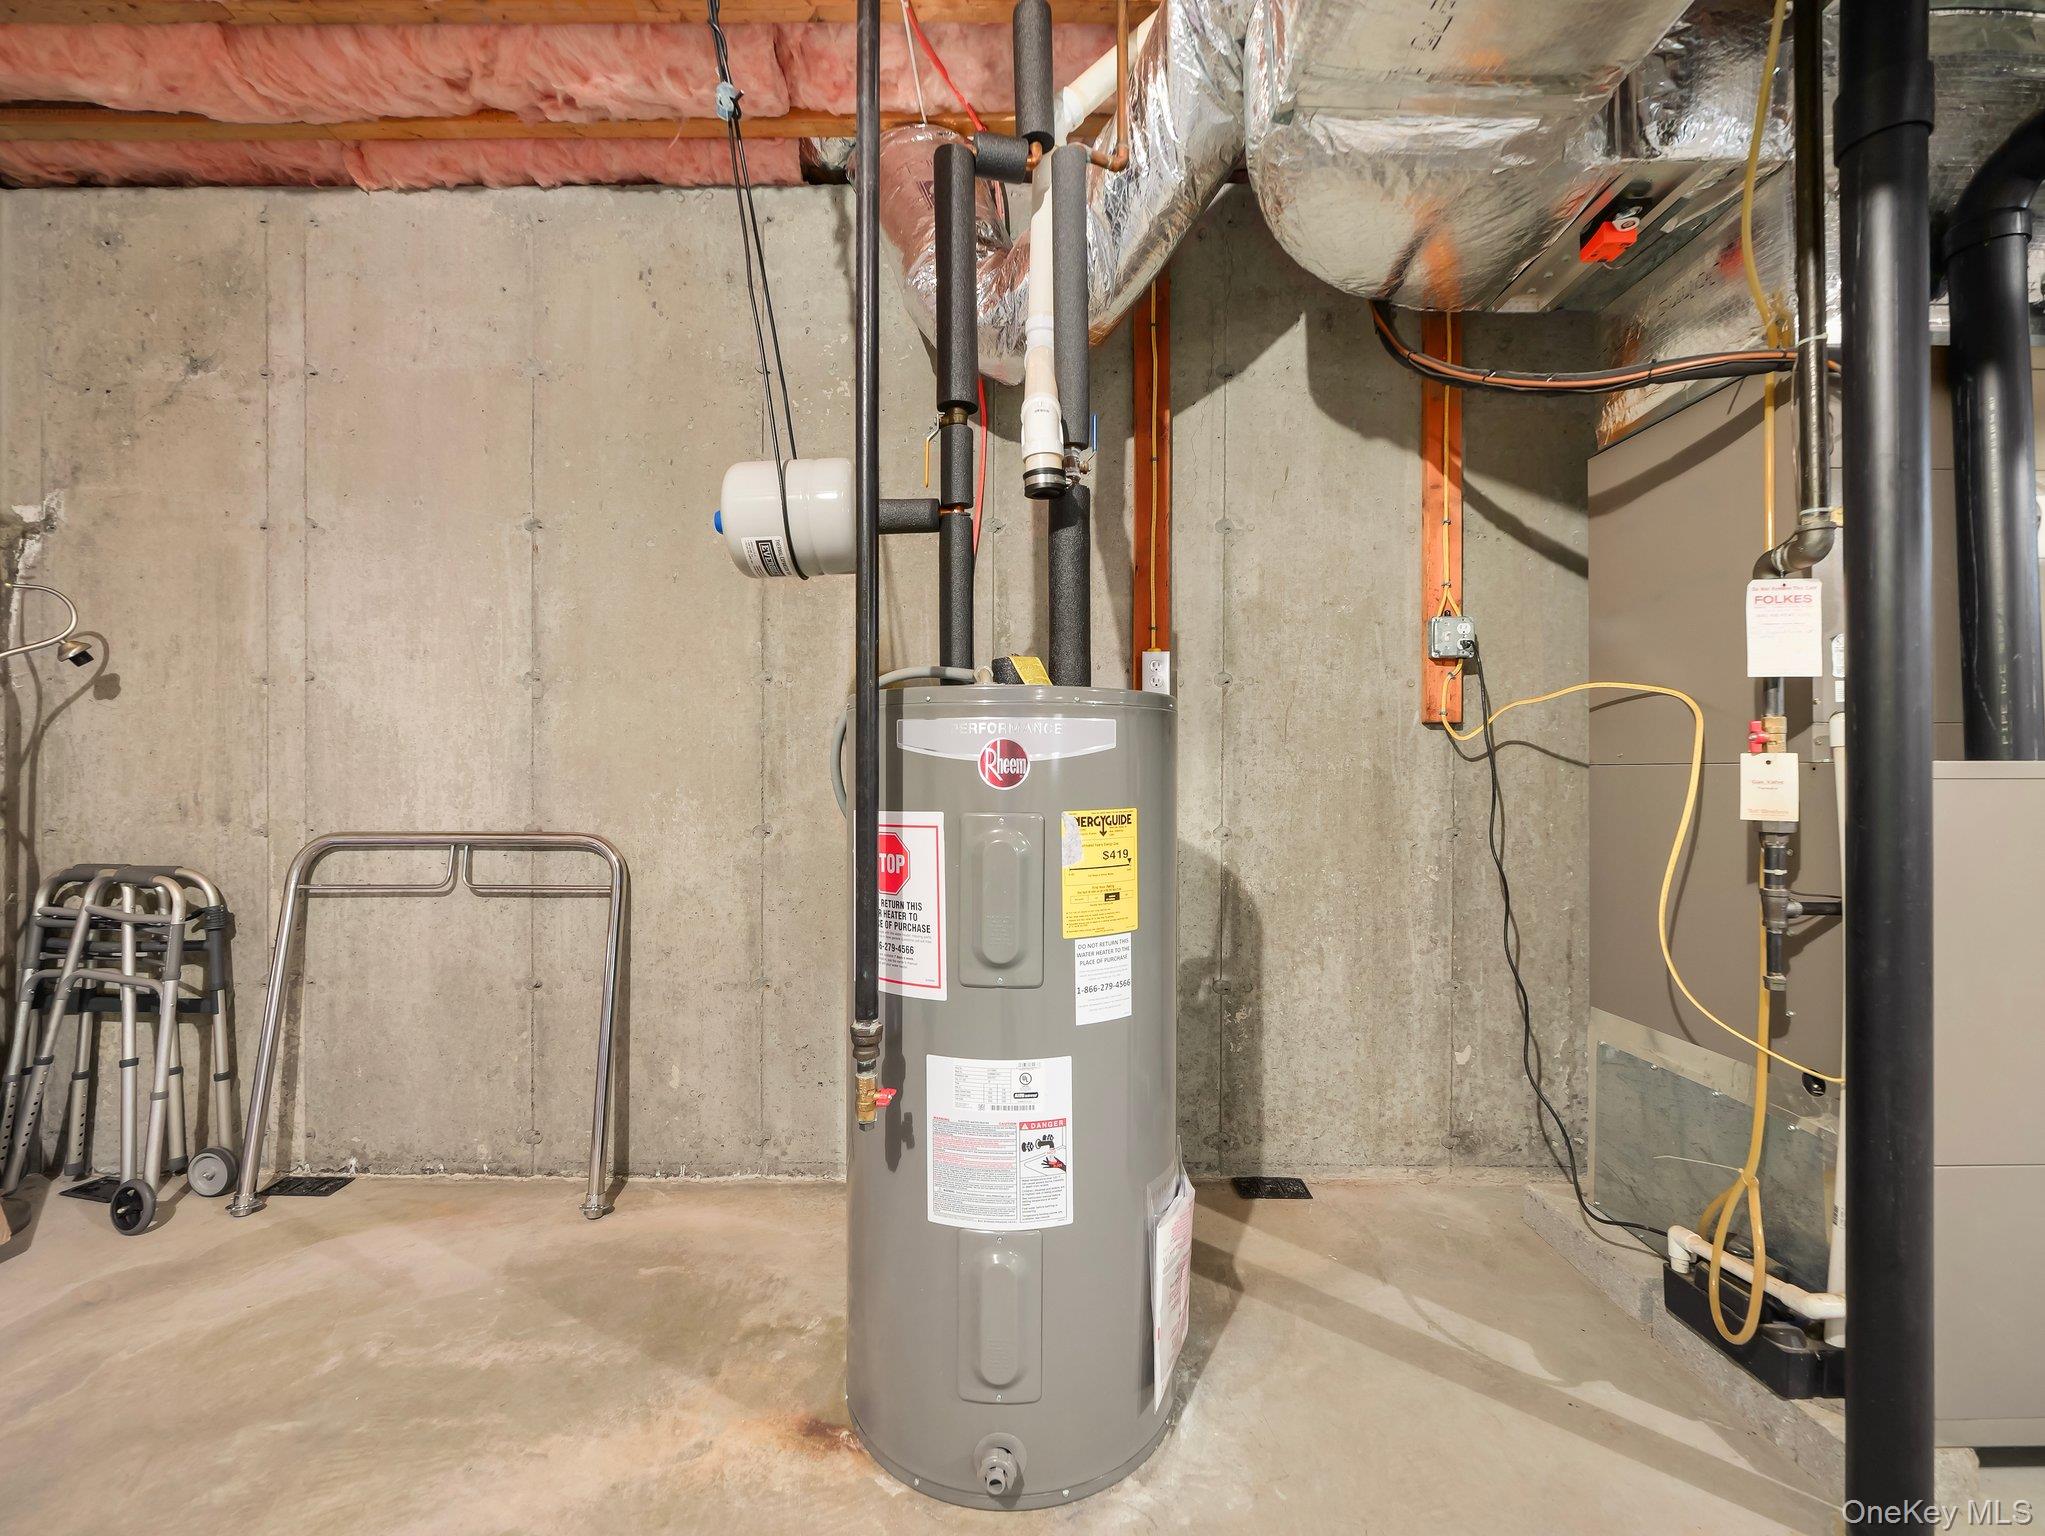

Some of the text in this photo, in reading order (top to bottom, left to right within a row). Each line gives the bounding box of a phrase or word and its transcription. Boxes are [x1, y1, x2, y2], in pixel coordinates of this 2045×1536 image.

[1754, 594, 1813, 604] FOLKES
[954, 722, 1063, 735] PERFORMANCE
[984, 740, 1027, 781] Rheem
[1074, 813, 1132, 828] NERGYGUIDE
[878, 853, 906, 874] TOP
[881, 899, 923, 911] RETURN THIS
[883, 910, 907, 921] HEATER
[909, 912, 918, 922] TO
[884, 920, 892, 930] OF
[894, 922, 931, 934] PURCHASE
[879, 941, 915, 955] 6-279-4566
[1099, 939, 1119, 948] RETURN
[1076, 950, 1095, 958] WATER
[1095, 948, 1114, 956] HEATER
[1104, 954, 1128, 963] PURCHASE
[1076, 978, 1131, 995] 1-866-279-4566
[1030, 1119, 1065, 1129] DANGER
